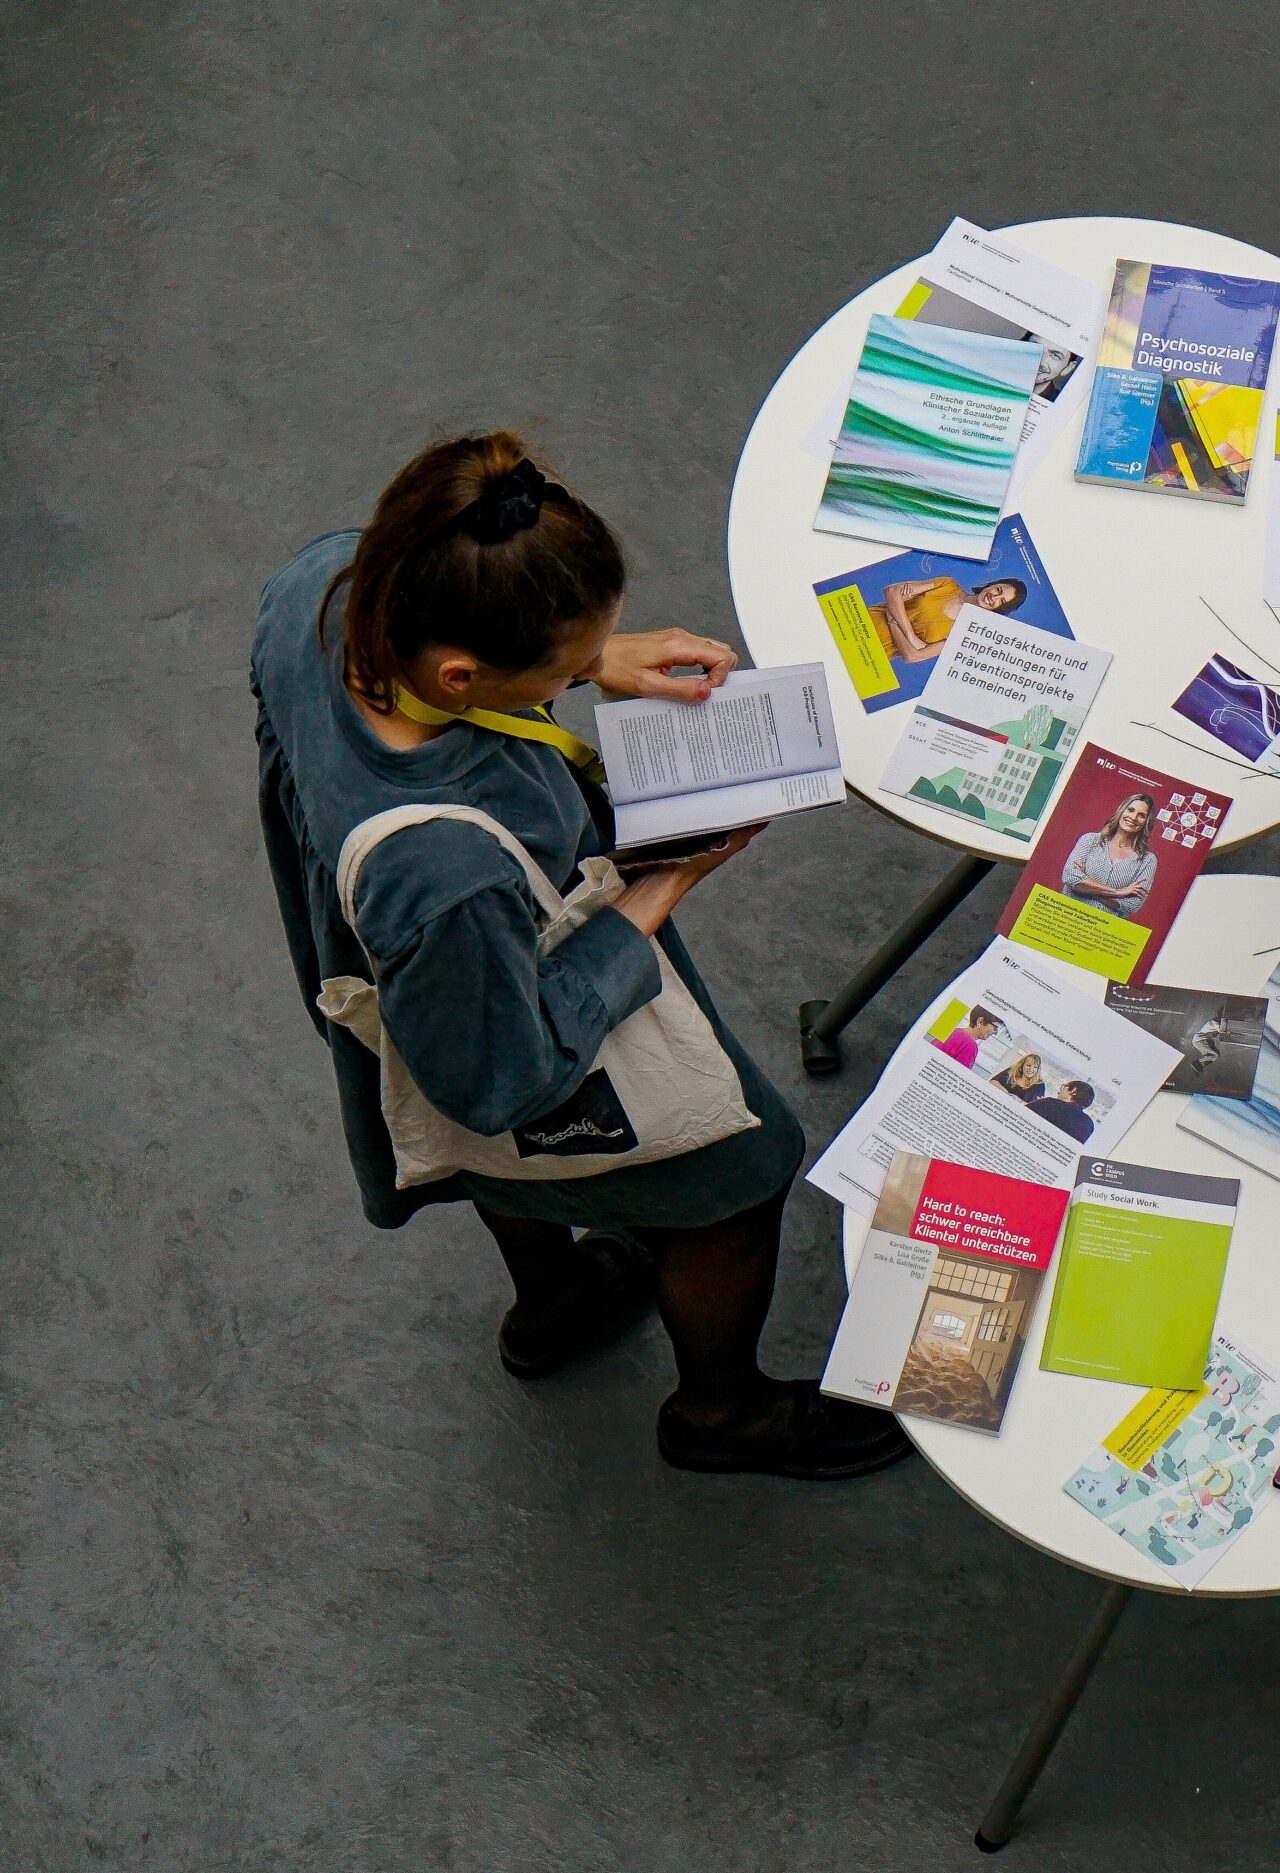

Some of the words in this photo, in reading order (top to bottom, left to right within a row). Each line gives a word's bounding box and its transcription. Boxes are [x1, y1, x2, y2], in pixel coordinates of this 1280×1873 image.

[1141, 332, 1255, 363] Psychosoziale
[1137, 350, 1223, 377] Diagnostik
[1120, 380, 1139, 388] Gernot
[922, 400, 961, 413] Klinischer
[963, 408, 1009, 423] Sozialarbeit
[929, 392, 964, 405] Ethische
[965, 399, 1011, 415] Grundlagen
[938, 425, 959, 434] Anton
[961, 429, 1004, 443] Schlittmaier
[951, 415, 980, 426] ergänzte
[982, 421, 1007, 432] Auflage
[860, 623, 871, 639] Digital
[967, 621, 1061, 662] Erfolgsfaktoren
[1064, 655, 1088, 671] und
[961, 637, 1047, 676] Empfehlungen
[1049, 668, 1067, 680] für
[946, 666, 959, 679] in
[960, 671, 1027, 703] Gemeinden
[954, 652, 1075, 701] Präventionsprojekte
[807, 685, 816, 709] Certificate
[1034, 897, 1062, 912] Diagnostik
[1037, 892, 1049, 901] CAS
[984, 988, 1032, 1021] Gesundheitsförderung
[1031, 1019, 1041, 1027] und
[1039, 1025, 1065, 1044] Nachhaltige
[1064, 1041, 1092, 1061] Entwicklung
[1086, 1189, 1108, 1200] Study
[1110, 1193, 1134, 1203] Social
[1135, 1198, 1158, 1208] Work.
[923, 1197, 951, 1214] Hard
[954, 1204, 967, 1216] to
[970, 1208, 1006, 1226] reach:
[918, 1213, 962, 1230] schwer
[963, 1223, 1031, 1247] erreichbare
[888, 1240, 912, 1251] Kersten
[912, 1246, 932, 1255] Giertz
[915, 1224, 959, 1244] Klientel
[961, 1235, 1037, 1263] unterstützen
[896, 1250, 909, 1258] Lisa
[910, 1253, 929, 1263] Große
[1158, 1399, 1167, 1408] und
